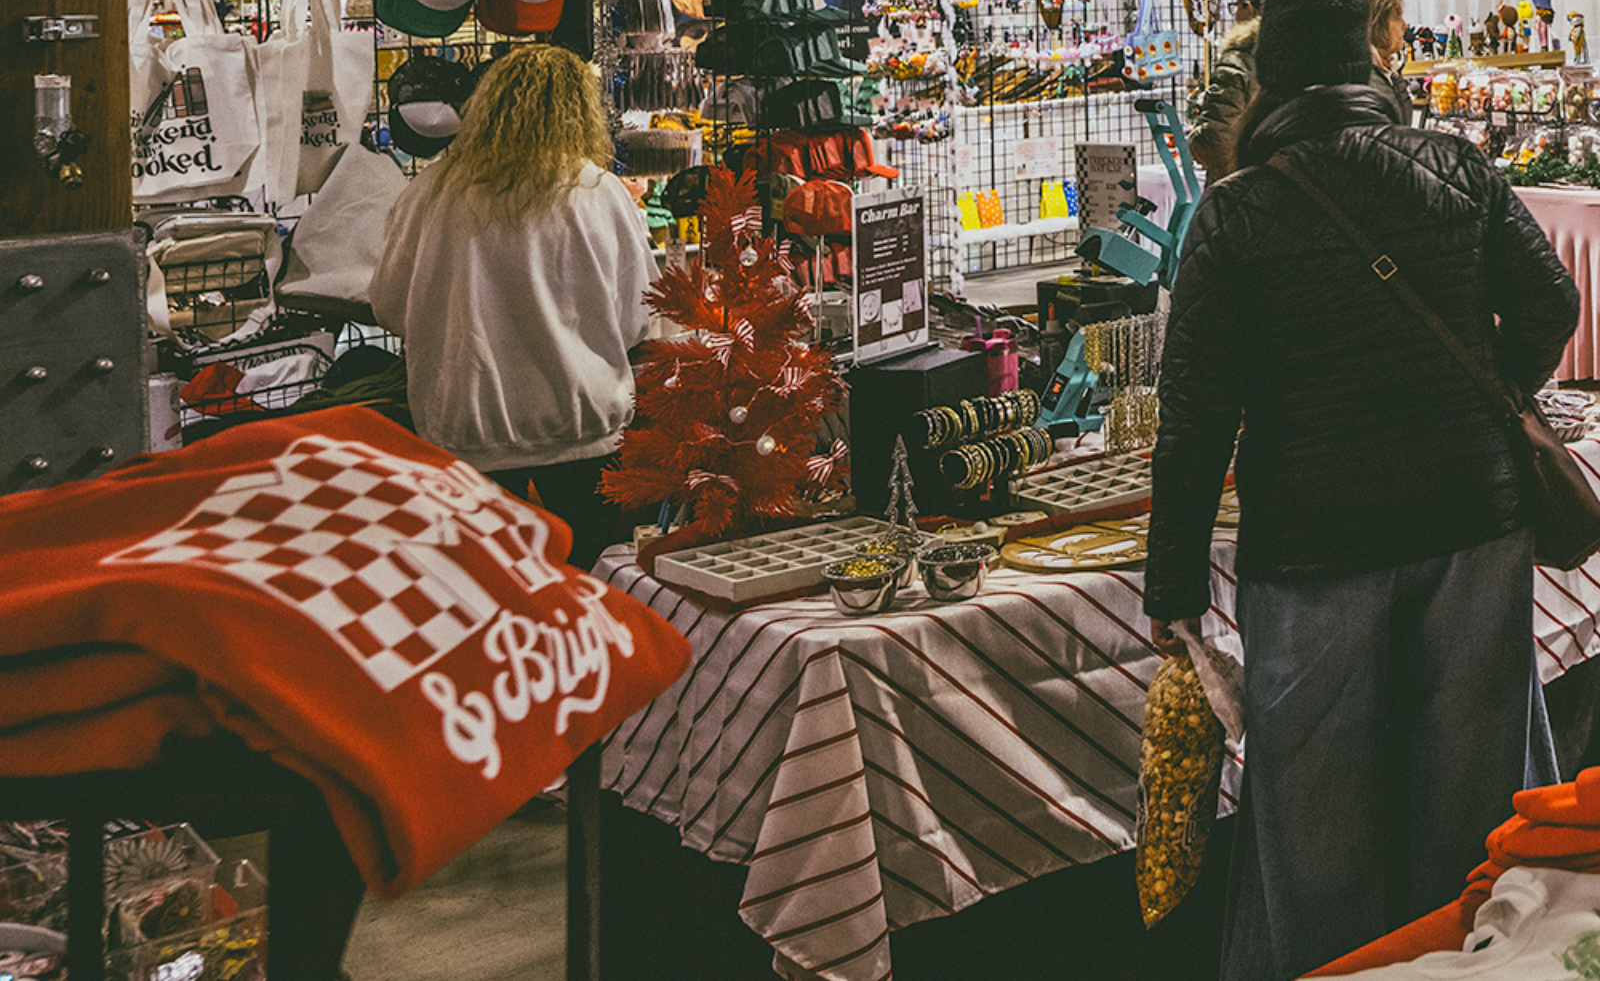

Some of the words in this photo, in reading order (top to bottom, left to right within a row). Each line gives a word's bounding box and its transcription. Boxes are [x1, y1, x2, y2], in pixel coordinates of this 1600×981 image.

[861, 208, 898, 224] Charm
[900, 203, 920, 217] Bar
[420, 671, 501, 780] &
